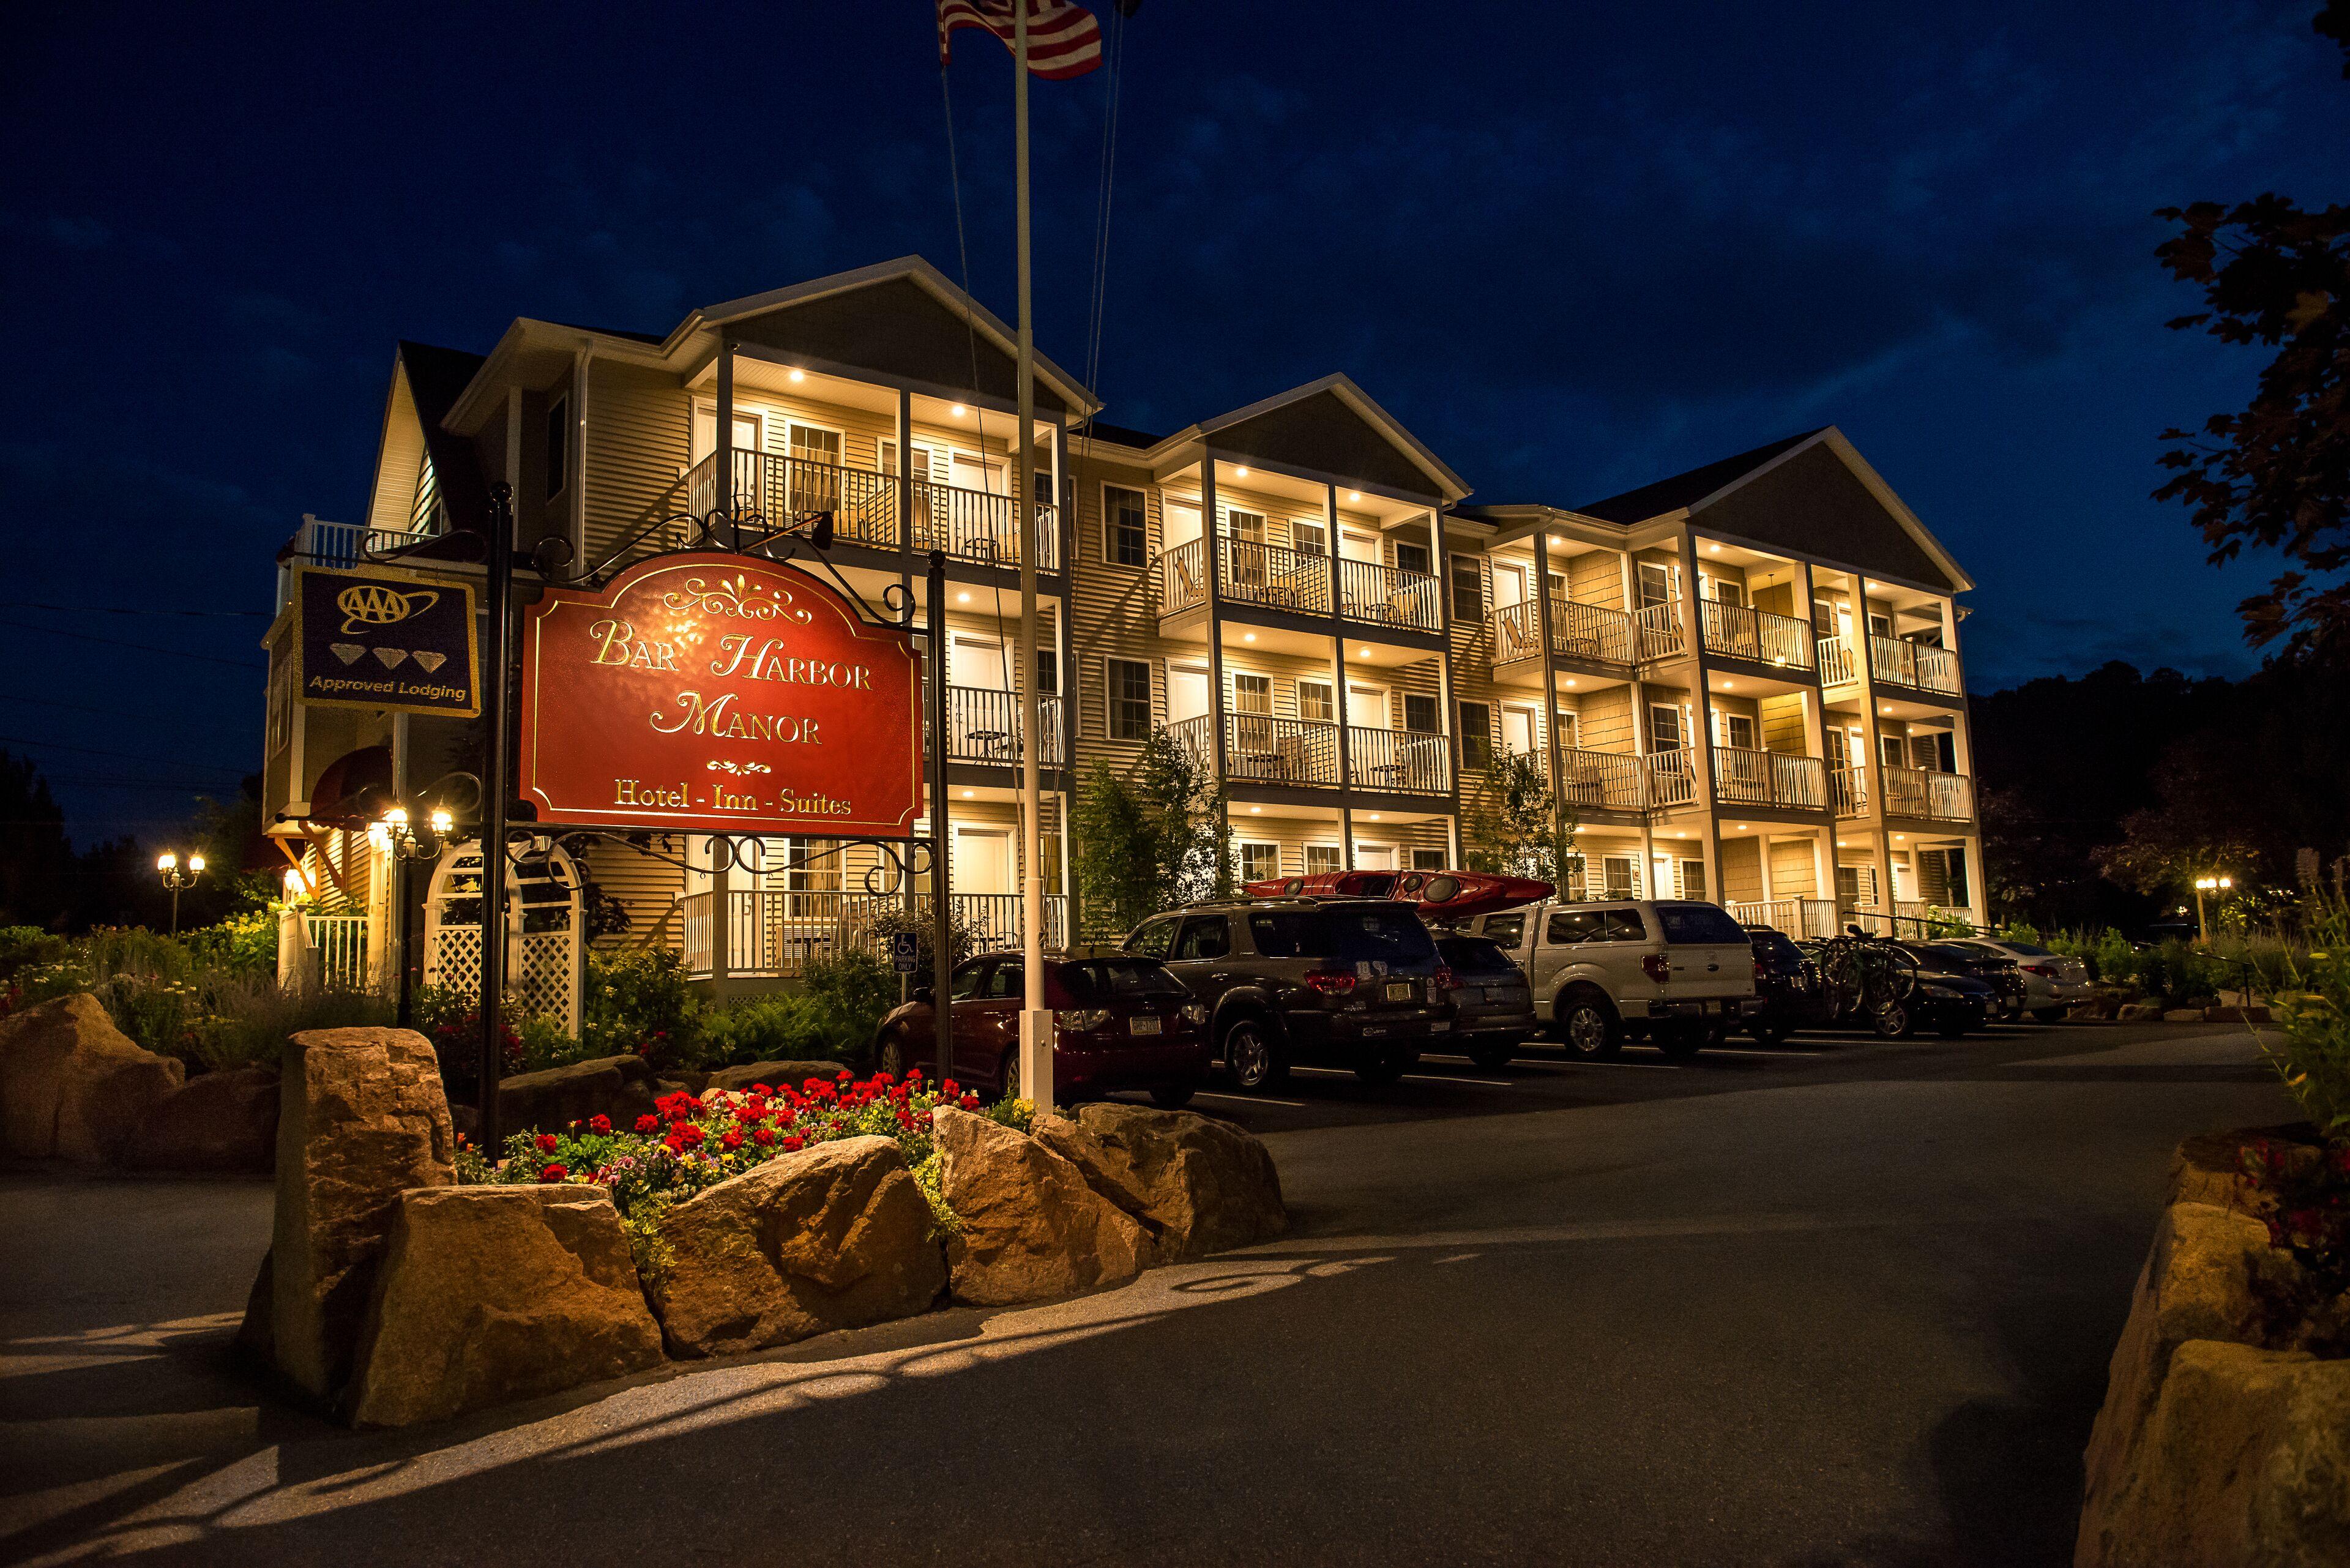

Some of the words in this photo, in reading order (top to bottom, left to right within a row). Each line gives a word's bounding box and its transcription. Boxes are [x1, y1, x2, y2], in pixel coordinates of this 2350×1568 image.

[346, 587, 403, 622] AAA
[589, 619, 680, 672] BAR
[710, 633, 873, 690] HARBOR
[308, 675, 395, 693] Approved
[398, 681, 466, 701] Lodging
[649, 689, 822, 744] MANOR
[614, 778, 690, 808] Hotel
[711, 783, 759, 811] Inn
[779, 788, 852, 815] Suites
